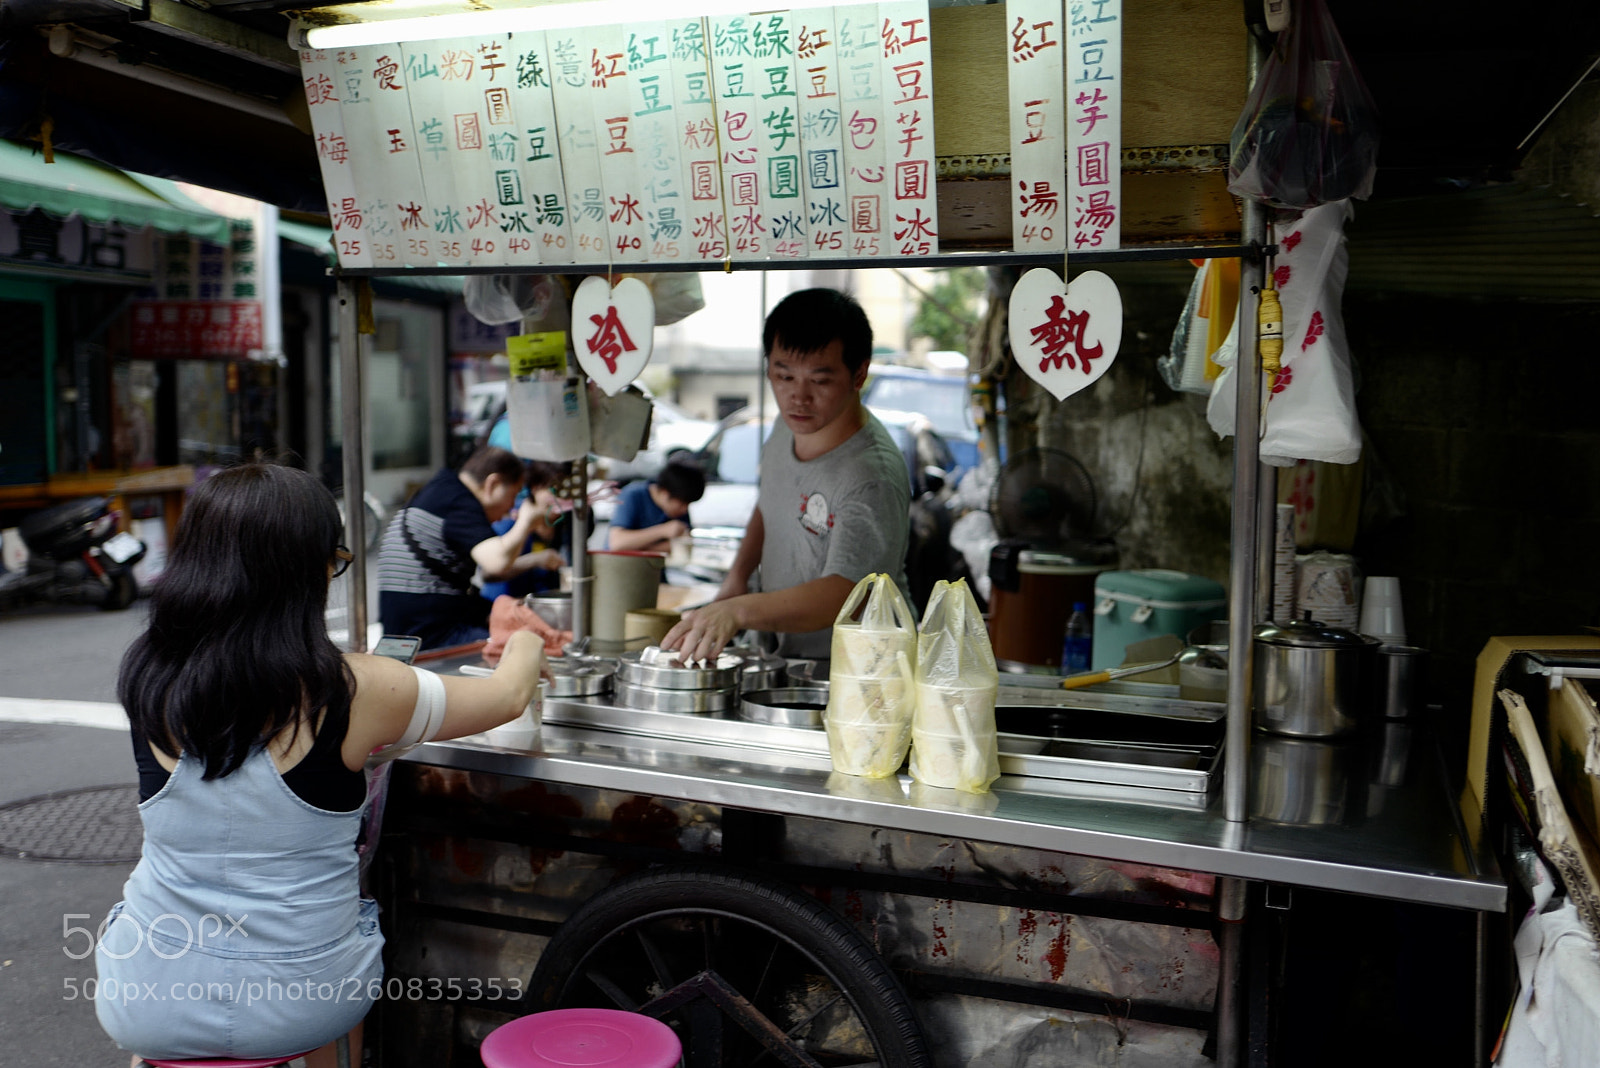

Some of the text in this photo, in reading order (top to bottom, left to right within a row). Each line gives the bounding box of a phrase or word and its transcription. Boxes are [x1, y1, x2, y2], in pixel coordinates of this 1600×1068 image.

[305, 73, 363, 255] 酸梅湯 25
[373, 55, 429, 231] 愛玉冰
[406, 53, 465, 234] 仙草冰
[440, 49, 498, 255] 粉圓冰 40
[477, 40, 534, 254] 芋圓粉圓冰 40
[516, 50, 566, 249] 綠豆湯 40
[555, 38, 604, 223] 薏仁湯
[591, 48, 643, 251] 紅豆冰 40
[672, 22, 725, 259] 綠豆粉圓冰 45
[715, 16, 766, 254] 綠豆包心圓冰 45
[753, 15, 806, 239] 綠豆芋圓冰
[798, 25, 847, 250] 紅豆粉圓冰 45
[838, 19, 884, 256] 紅豆包心圓 45
[881, 18, 937, 257] 紅豆芋圓冰 45
[1011, 17, 1058, 242] 紅豆湯 40
[1071, 0, 1117, 250] 紅豆芋圓湯 45
[586, 305, 638, 375] 冷
[1030, 295, 1103, 375] 熱
